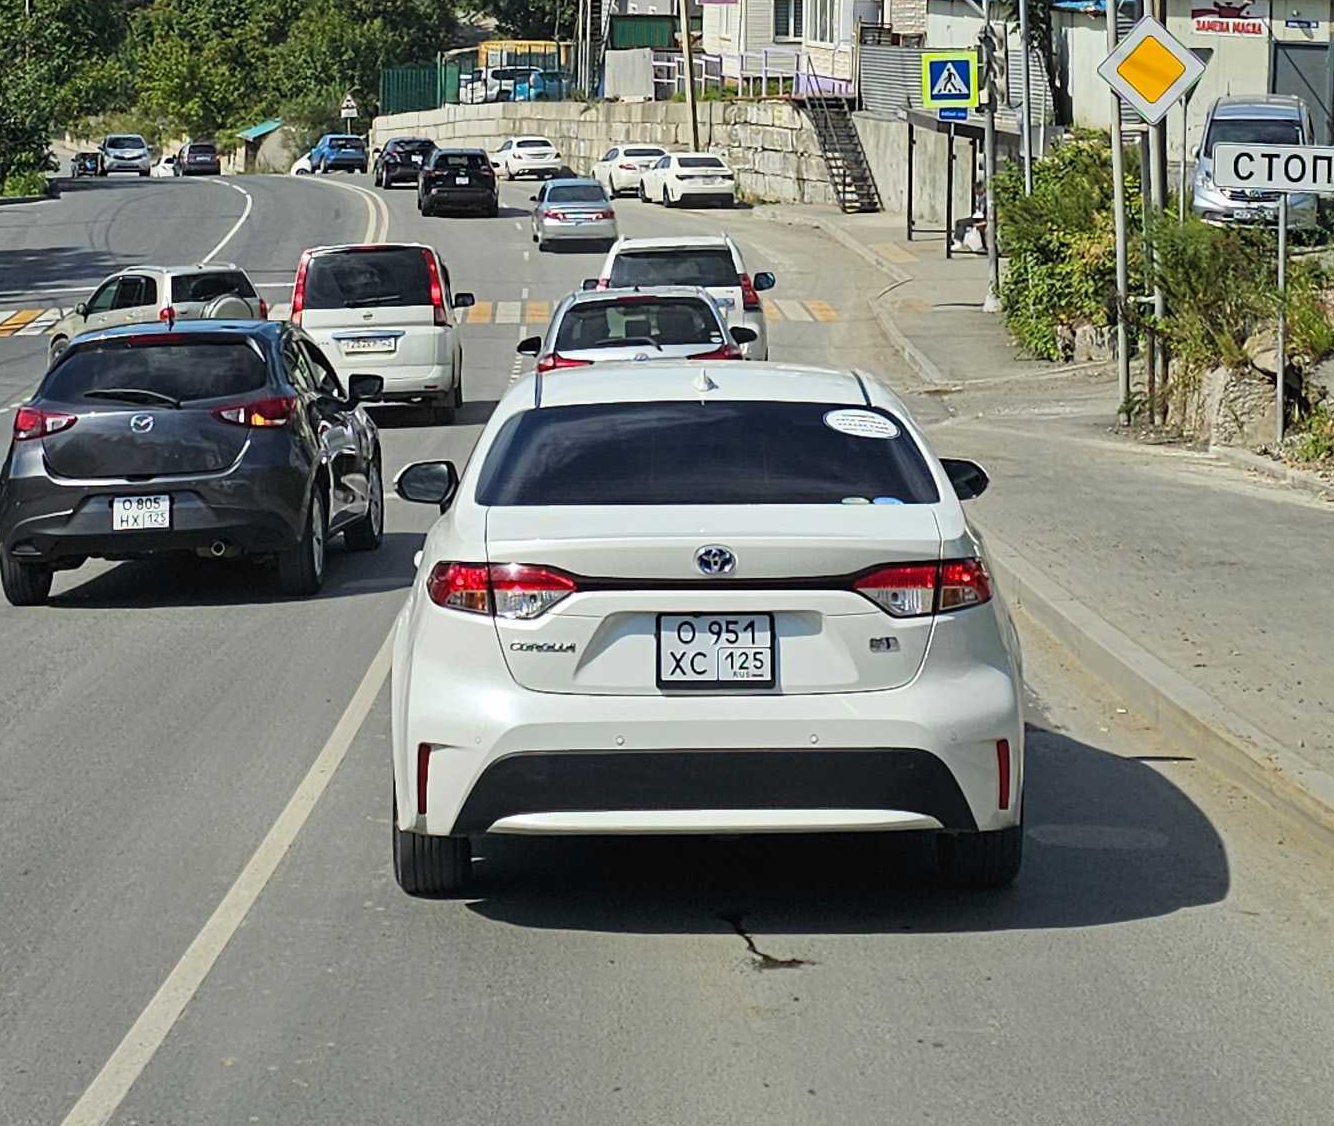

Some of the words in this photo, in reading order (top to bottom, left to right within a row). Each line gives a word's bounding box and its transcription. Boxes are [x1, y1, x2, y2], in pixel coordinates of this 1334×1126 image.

[1233, 152, 1334, 184] СТОП
[136, 497, 161, 510] 805
[708, 620, 755, 645] 951
[669, 651, 708, 676] ХС
[724, 651, 764, 671] 125
